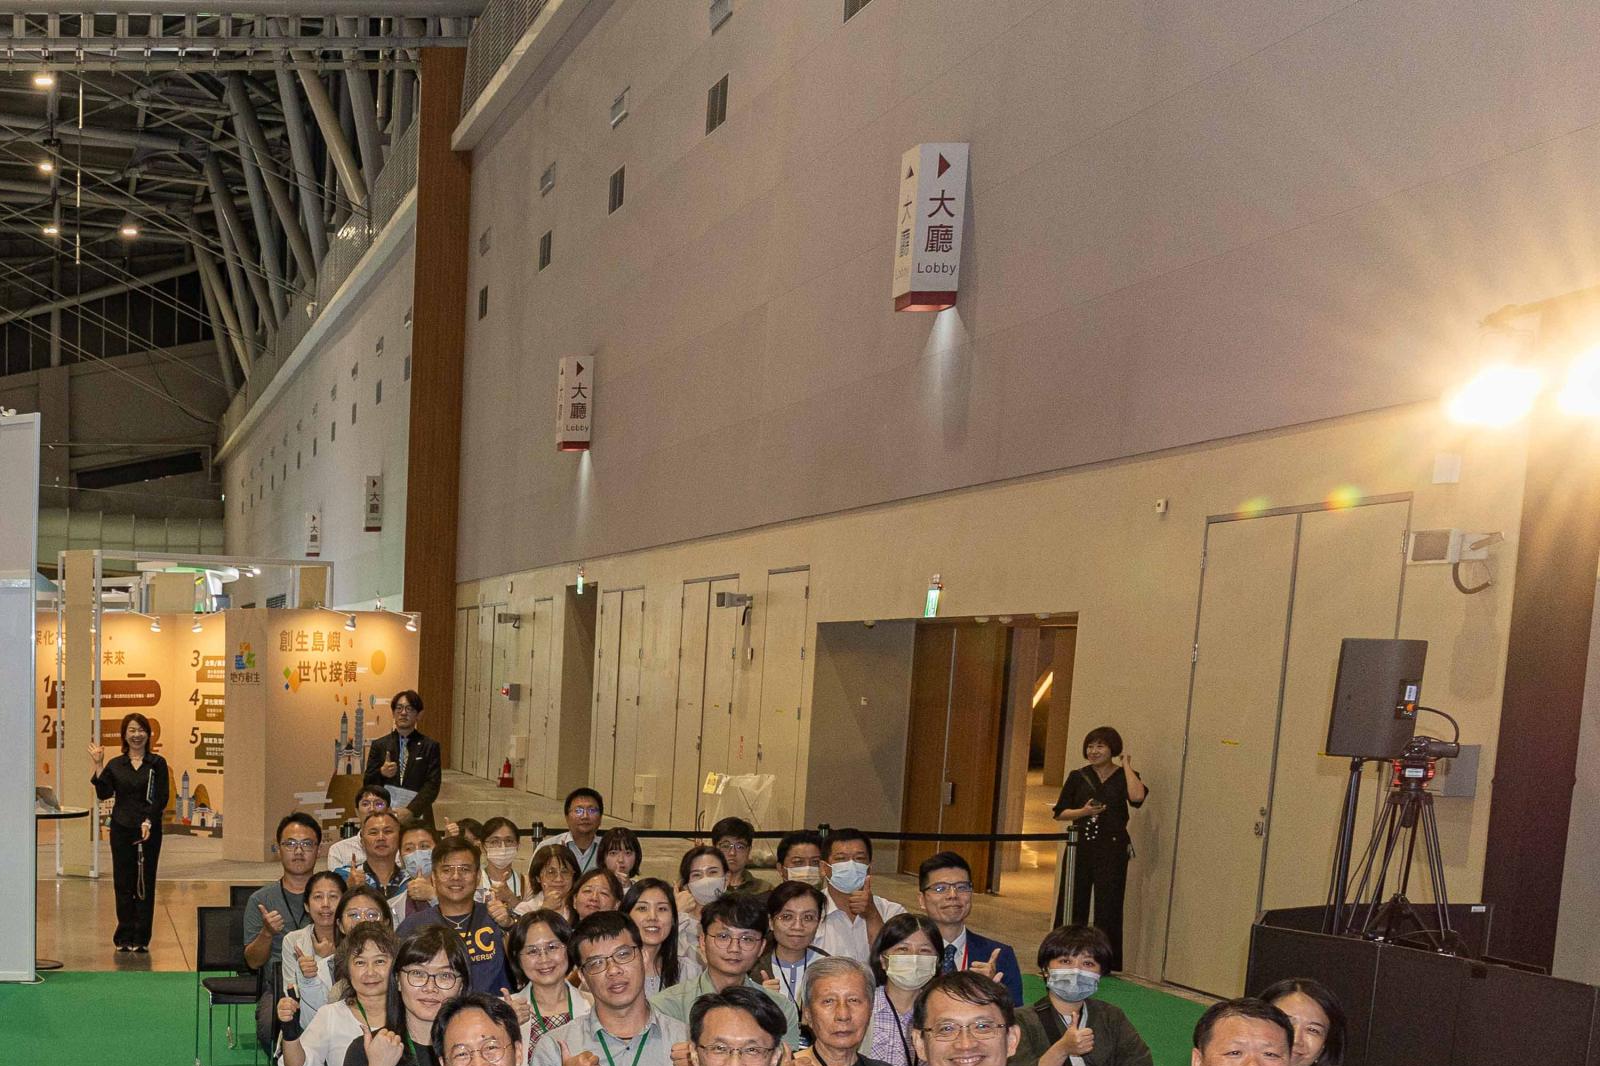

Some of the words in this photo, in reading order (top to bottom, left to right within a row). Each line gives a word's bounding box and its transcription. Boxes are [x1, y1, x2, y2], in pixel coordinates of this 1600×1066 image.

[925, 189, 956, 253] 大廳
[917, 262, 956, 275] Lobby
[570, 383, 587, 419] 大廳
[280, 630, 341, 652] 創生島嶼
[103, 651, 125, 666] 未來
[191, 650, 200, 667] 3
[230, 671, 261, 683] 地方創生
[297, 660, 358, 683] 世代接續
[44, 675, 50, 693] 1
[189, 689, 199, 705] 4
[41, 715, 50, 733] 2
[190, 727, 199, 744] 5
